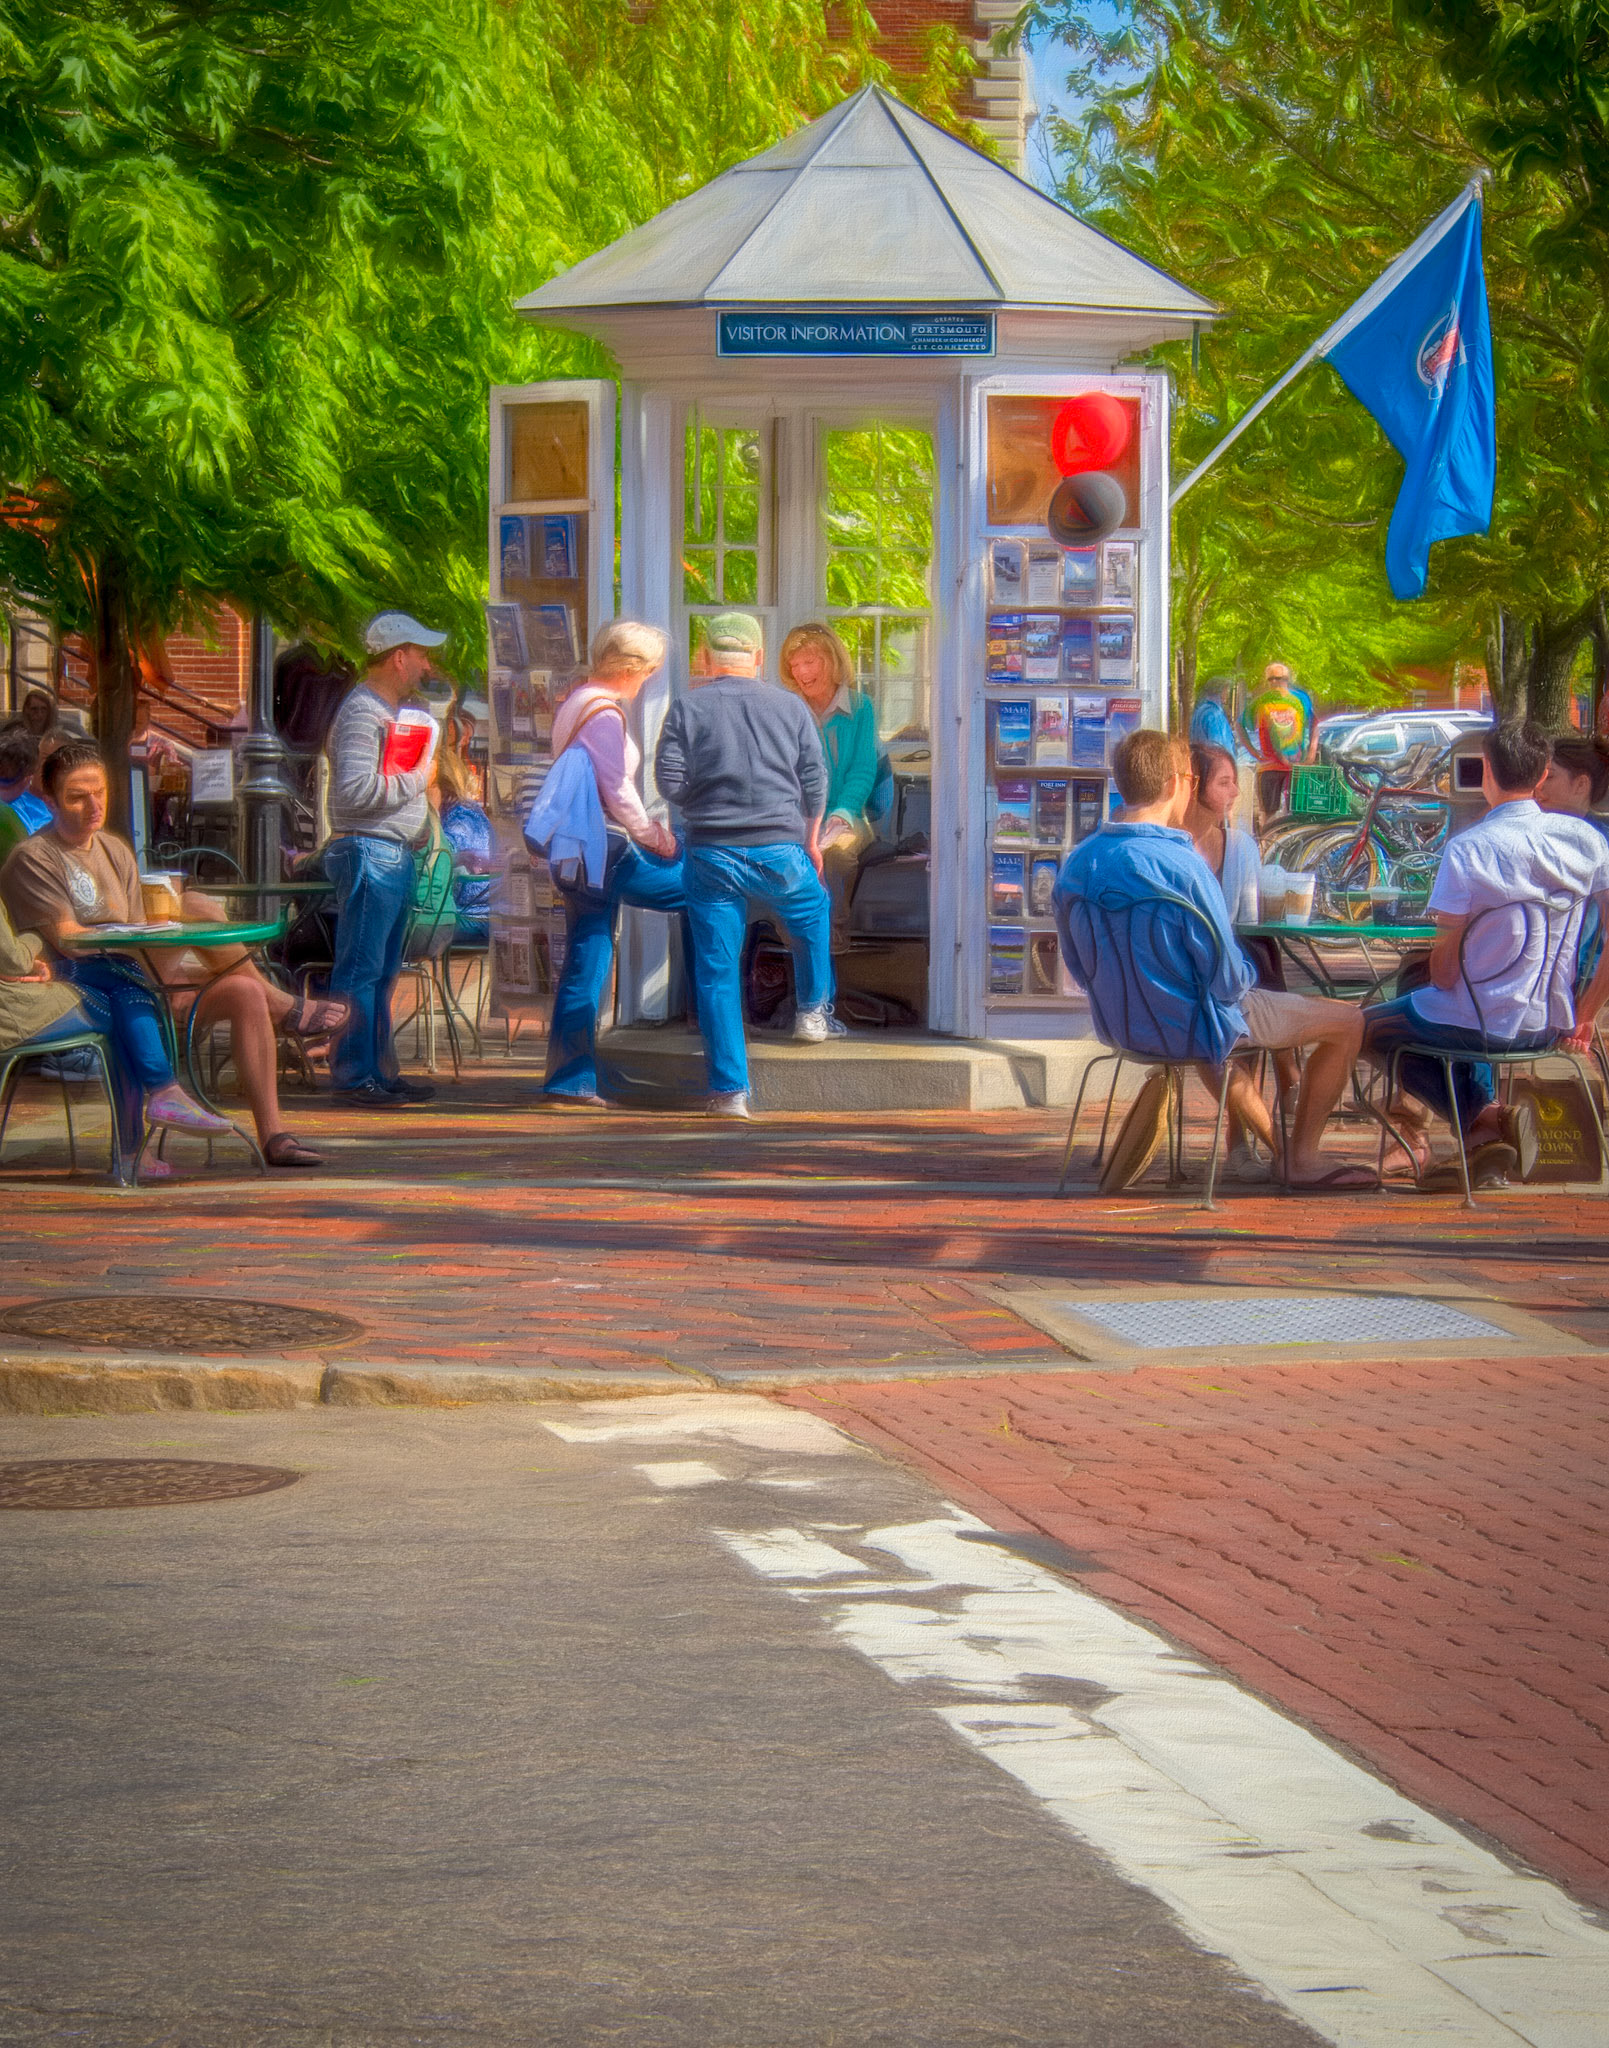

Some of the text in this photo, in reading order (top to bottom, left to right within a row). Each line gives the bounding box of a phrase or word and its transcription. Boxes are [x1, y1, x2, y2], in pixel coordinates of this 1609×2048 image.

[727, 327, 905, 340] VISITOR INFORMATION
[912, 326, 987, 334] PORTSMOUTH
[1537, 1142, 1574, 1152] ROWN
